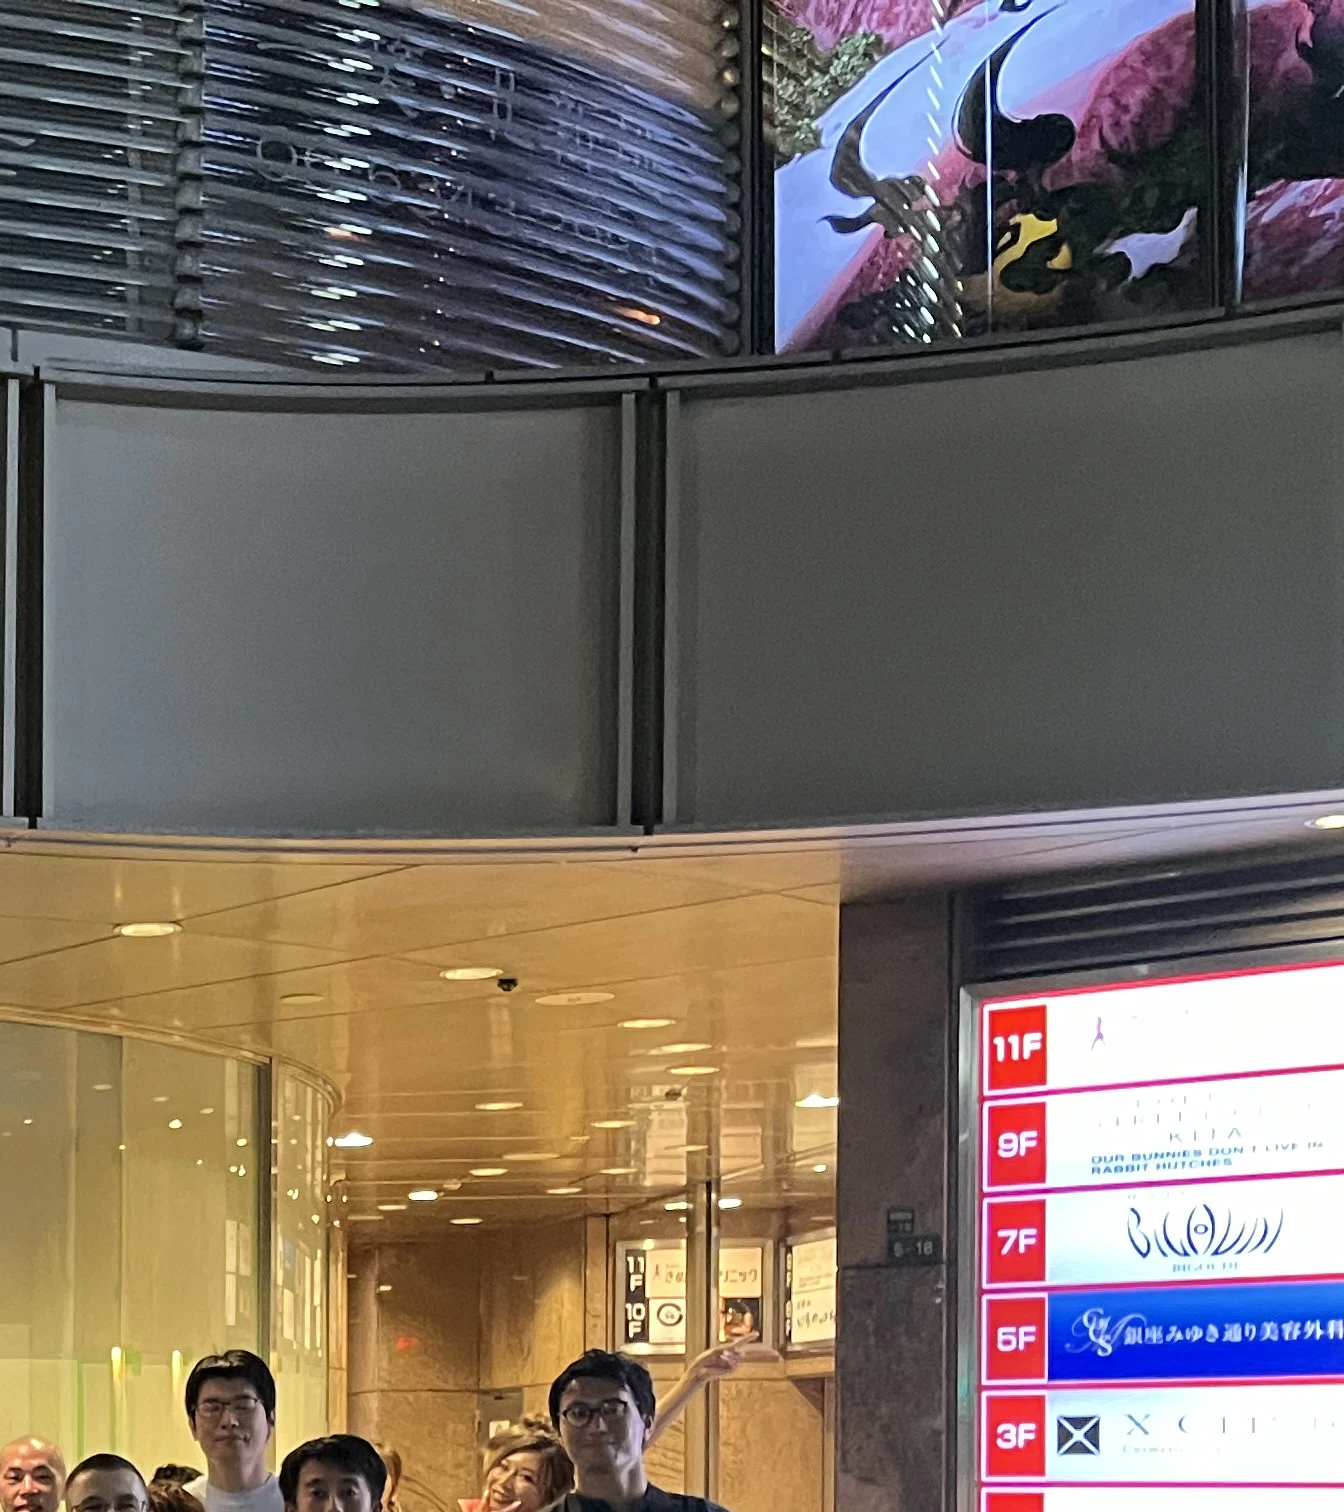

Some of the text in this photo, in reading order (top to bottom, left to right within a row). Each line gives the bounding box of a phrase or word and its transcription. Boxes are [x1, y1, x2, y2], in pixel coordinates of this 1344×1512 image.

[993, 1032, 1043, 1062] 11F
[998, 1130, 1038, 1158] 9F
[997, 1228, 1037, 1255] 7F
[626, 1256, 645, 1274] 11
[625, 1302, 646, 1321] 10
[996, 1422, 1037, 1449] 3F
